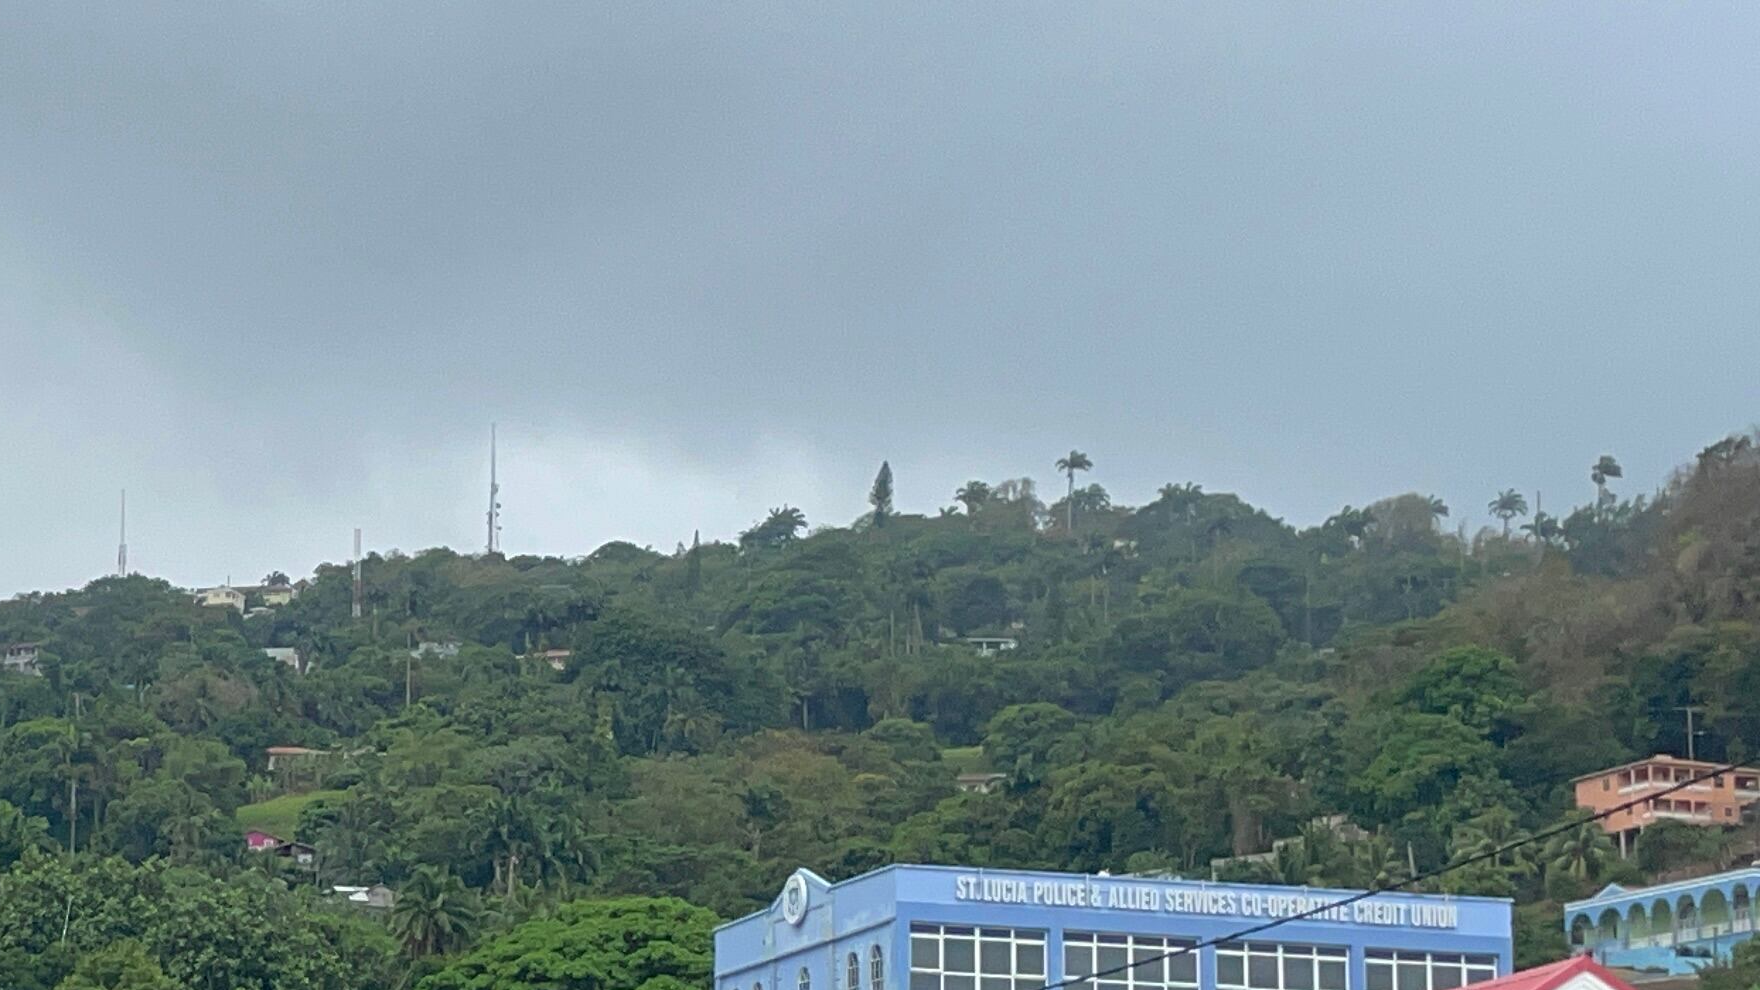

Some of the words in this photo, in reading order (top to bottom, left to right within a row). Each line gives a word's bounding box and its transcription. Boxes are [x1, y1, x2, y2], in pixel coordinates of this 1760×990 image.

[1034, 881, 1086, 907] POLICE
[1090, 884, 1102, 908] &
[1108, 886, 1160, 911] ALLIED
[1165, 888, 1236, 914] SERVICES
[1241, 892, 1348, 921] CO-OPERATIVE
[1353, 900, 1407, 925] CREDIT
[1411, 904, 1458, 928] UNION
